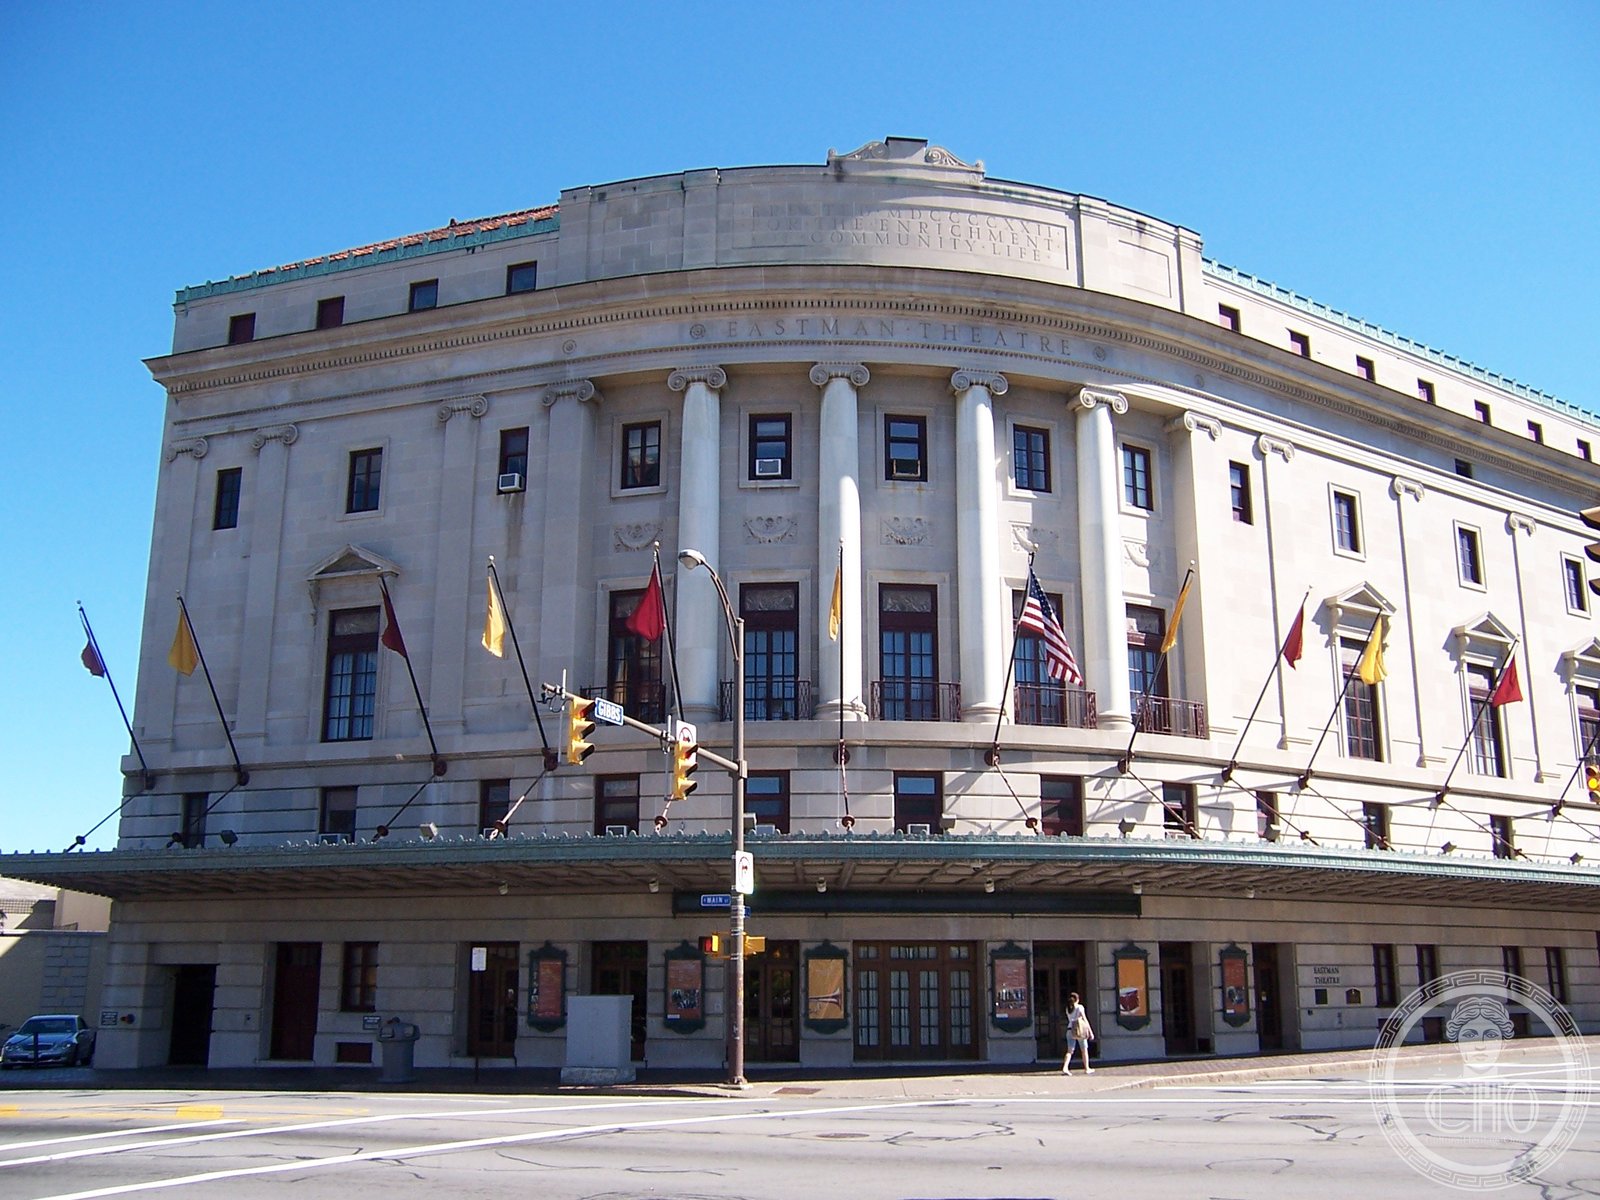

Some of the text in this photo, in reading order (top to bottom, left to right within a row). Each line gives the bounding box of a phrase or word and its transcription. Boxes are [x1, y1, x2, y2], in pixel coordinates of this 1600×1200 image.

[814, 217, 863, 231] THE
[879, 218, 1054, 251] ENRICHMENT
[887, 209, 1053, 238] MDCCCCXXII
[810, 231, 976, 252] COMMUNITY
[992, 242, 1041, 262] LIFE
[727, 318, 1071, 356] EASTMAN THEATRE
[598, 701, 621, 721] GIBBS
[707, 896, 723, 904] MAIN
[1313, 966, 1340, 974] EASTMAN
[1314, 976, 1340, 984] THEATRE
